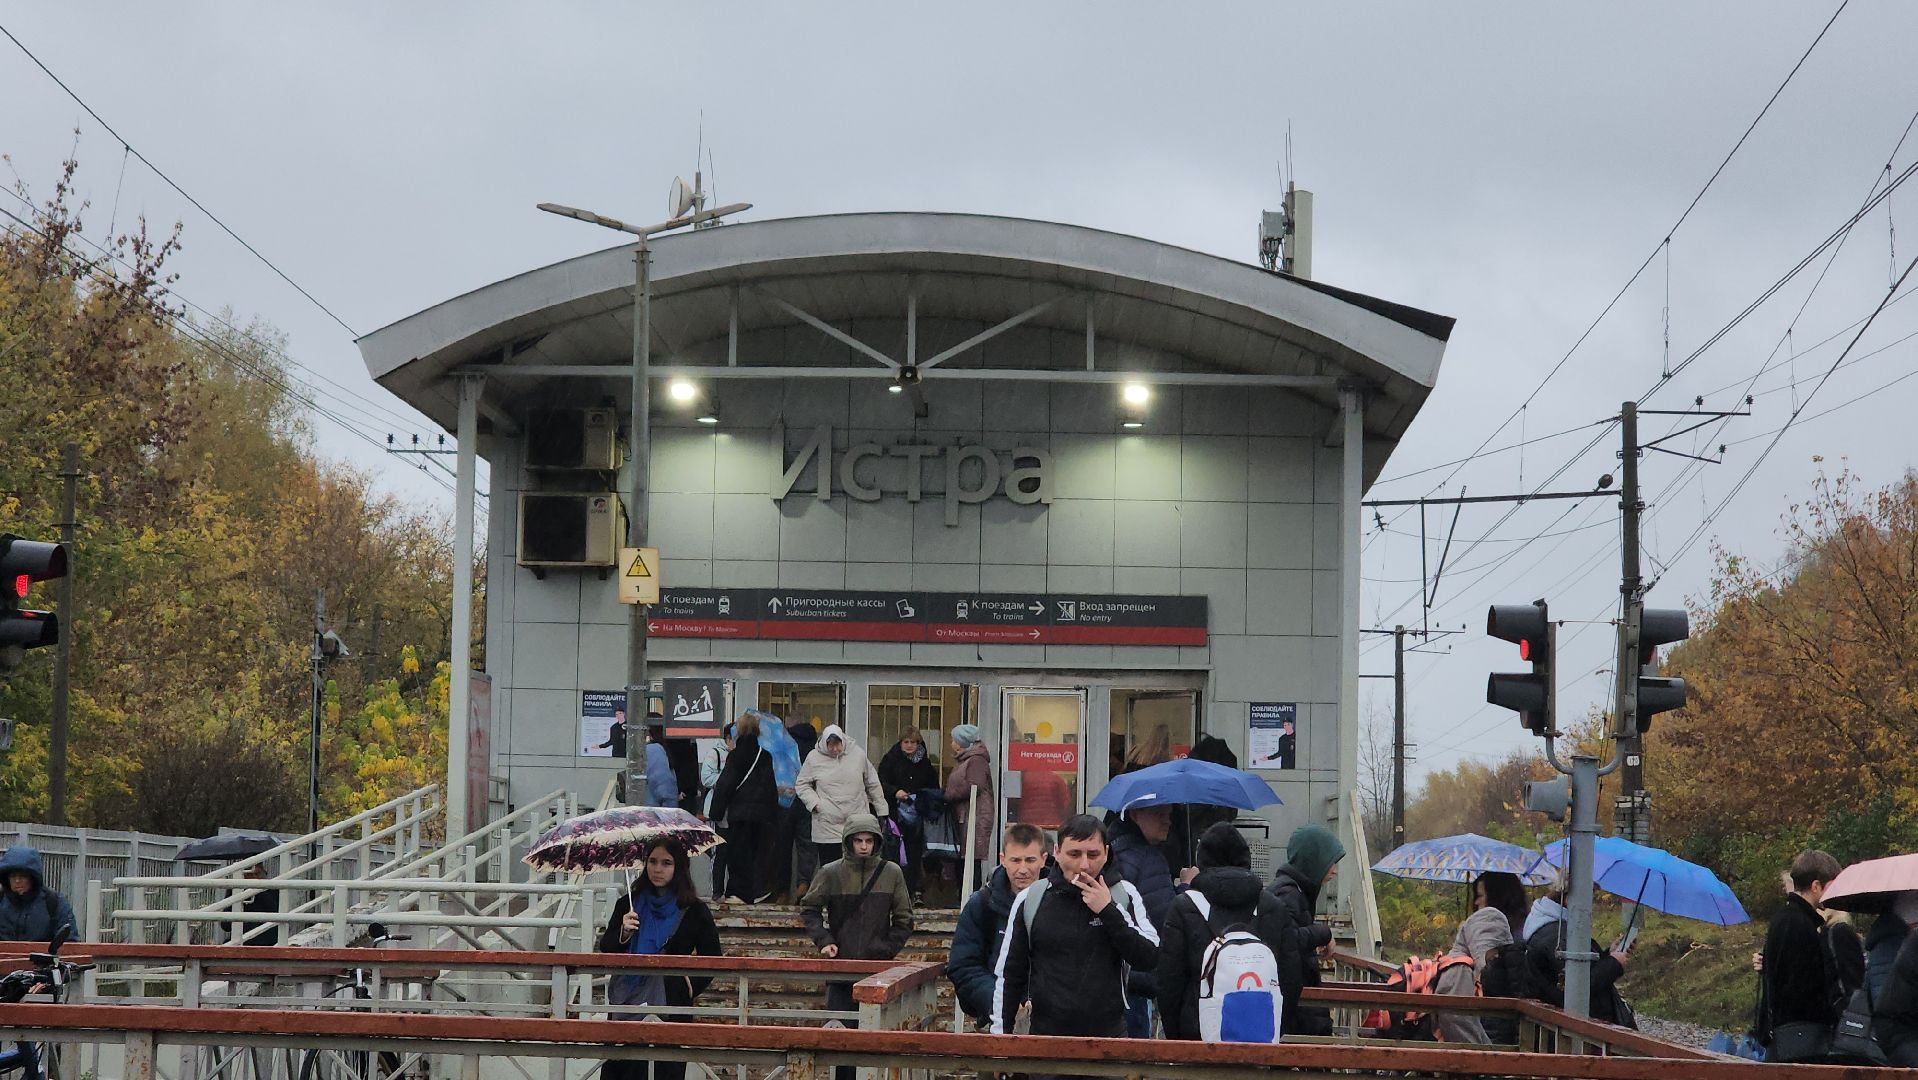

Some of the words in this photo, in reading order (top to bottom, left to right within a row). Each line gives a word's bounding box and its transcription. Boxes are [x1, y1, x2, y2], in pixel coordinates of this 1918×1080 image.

[770, 423, 1054, 528] Истра
[634, 585, 640, 593] 1
[663, 594, 670, 604] К
[672, 595, 715, 605] поездам
[785, 596, 855, 608] Пригородные
[857, 599, 886, 608] кассы
[972, 599, 980, 609] К
[981, 601, 1025, 611] поездам
[1079, 601, 1104, 612] Вход
[1105, 602, 1156, 613] запрещен
[663, 606, 672, 614] To
[673, 607, 694, 615] trains
[785, 609, 822, 617] Suburban
[823, 609, 847, 618] tickets
[993, 612, 1002, 620] To
[1003, 612, 1024, 621] trains
[1079, 614, 1091, 622] No
[1092, 614, 1113, 623] entry
[662, 623, 673, 632] На
[674, 624, 702, 633] Москву
[948, 628, 980, 637] Москвы
[584, 694, 626, 702] СОБЛЮДАЙТЕ
[1034, 752, 1062, 760] прохода
